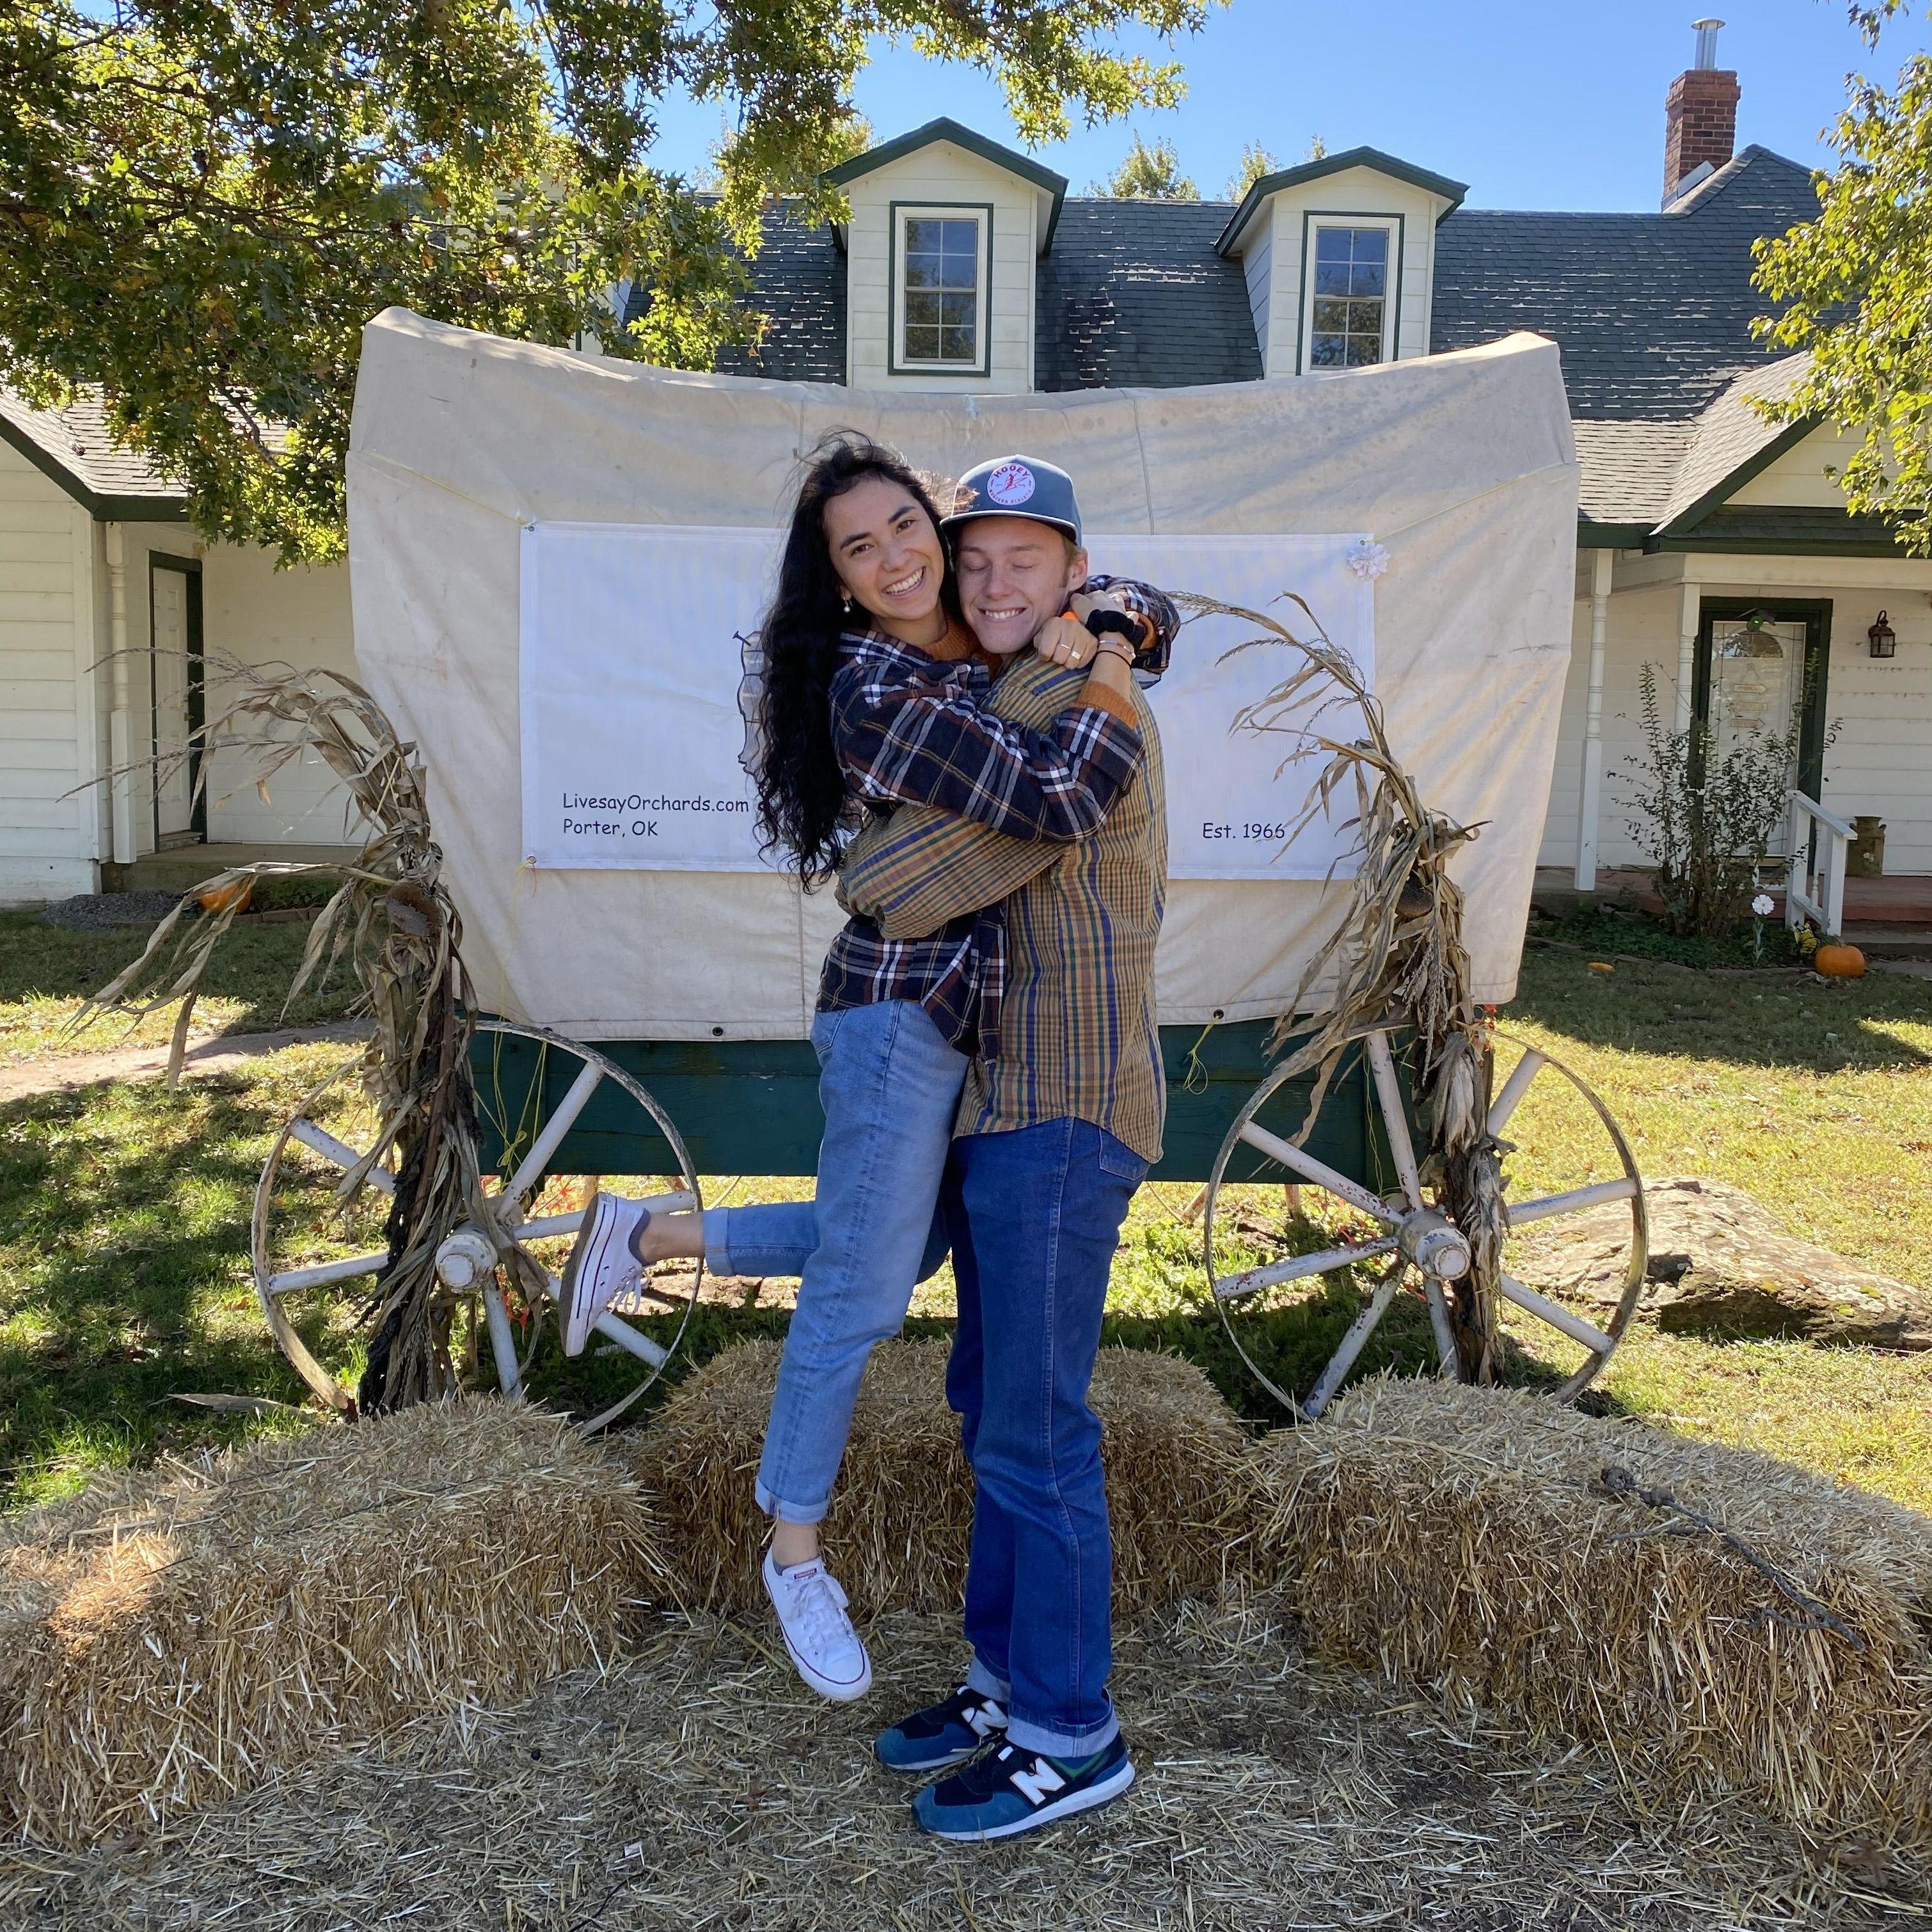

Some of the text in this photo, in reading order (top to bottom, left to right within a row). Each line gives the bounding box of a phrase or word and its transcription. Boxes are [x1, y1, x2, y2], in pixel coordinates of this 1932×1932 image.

[993, 465, 1031, 478] HOOEY
[563, 793, 749, 814] LivesayOrchards.com
[564, 818, 658, 837] Porter, OK
[1203, 822, 1285, 839] Est. 1966
[1010, 1757, 1066, 1805] N
